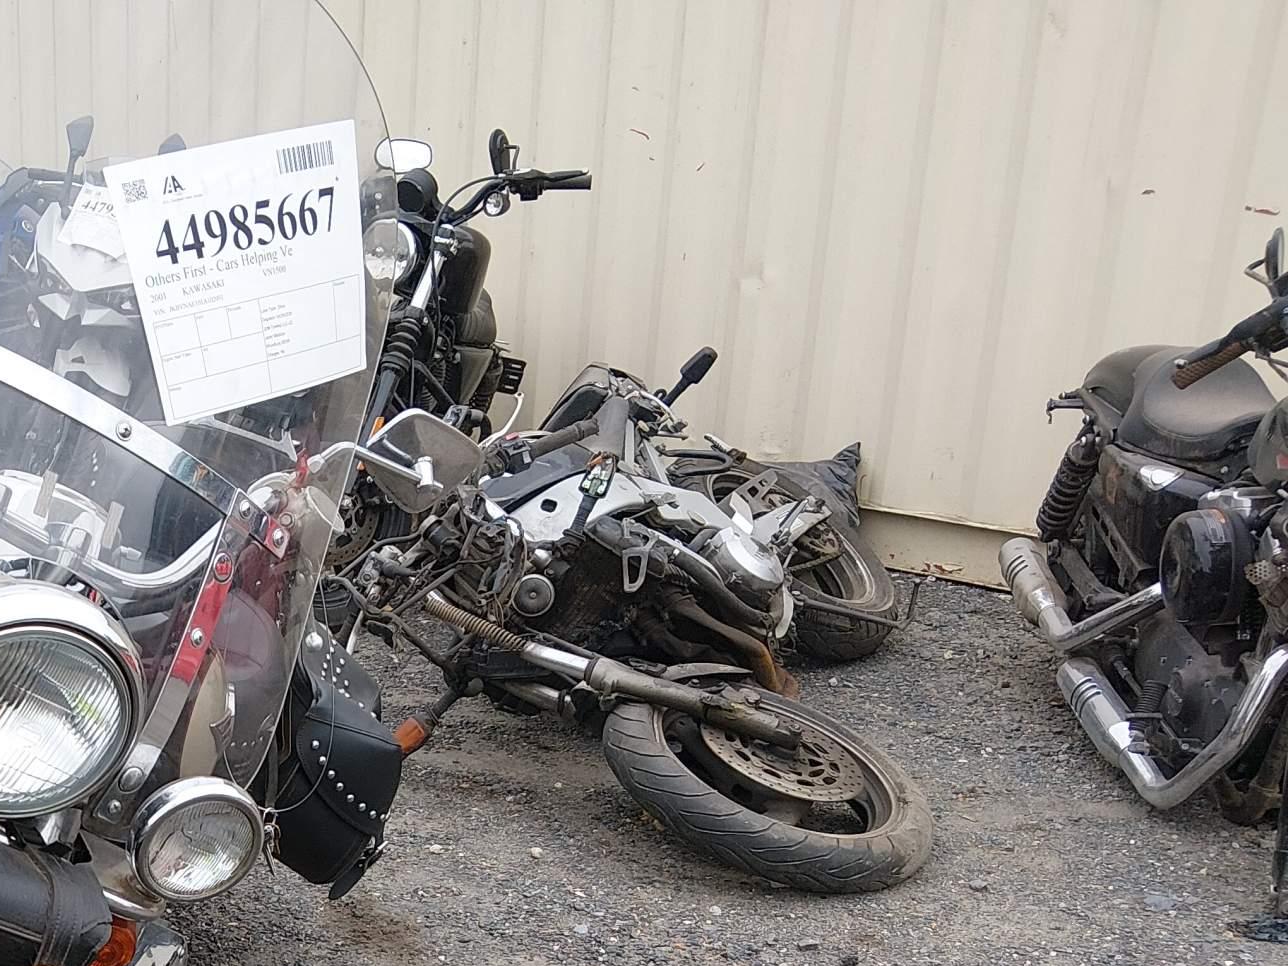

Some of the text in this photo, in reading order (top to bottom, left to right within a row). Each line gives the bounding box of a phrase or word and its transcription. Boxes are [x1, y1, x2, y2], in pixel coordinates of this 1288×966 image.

[155, 186, 335, 265] 44985667
[145, 270, 182, 289] Others
[183, 264, 207, 280] First
[216, 258, 239, 273] Cars
[241, 249, 278, 268] Helping
[280, 245, 294, 258] Ve
[182, 279, 225, 297] KAWASAKI
